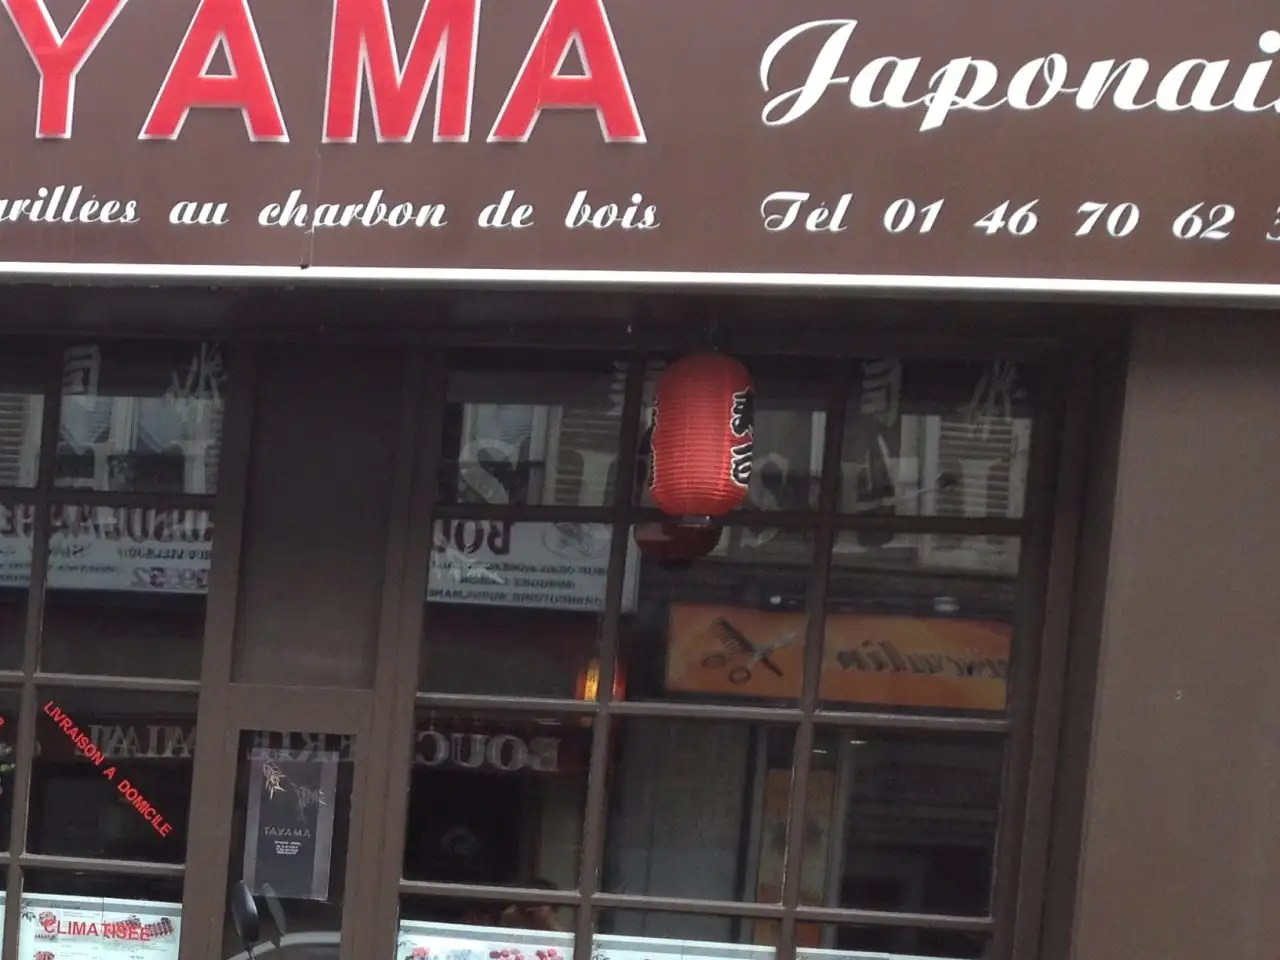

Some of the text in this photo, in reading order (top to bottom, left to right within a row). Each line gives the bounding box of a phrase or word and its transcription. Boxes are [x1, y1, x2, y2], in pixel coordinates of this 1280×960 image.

[760, 19, 1280, 132] Japonai
[169, 202, 228, 226] au
[258, 190, 447, 230] charbon
[478, 190, 533, 229] de
[565, 190, 659, 230] bois
[884, 199, 944, 233] 01
[974, 199, 1038, 236] 46
[1075, 202, 1139, 238] 70
[1173, 203, 1235, 240] 62
[43, 700, 106, 767] LIVRAISON
[103, 766, 117, 780] A
[117, 780, 173, 838] DOMICILE
